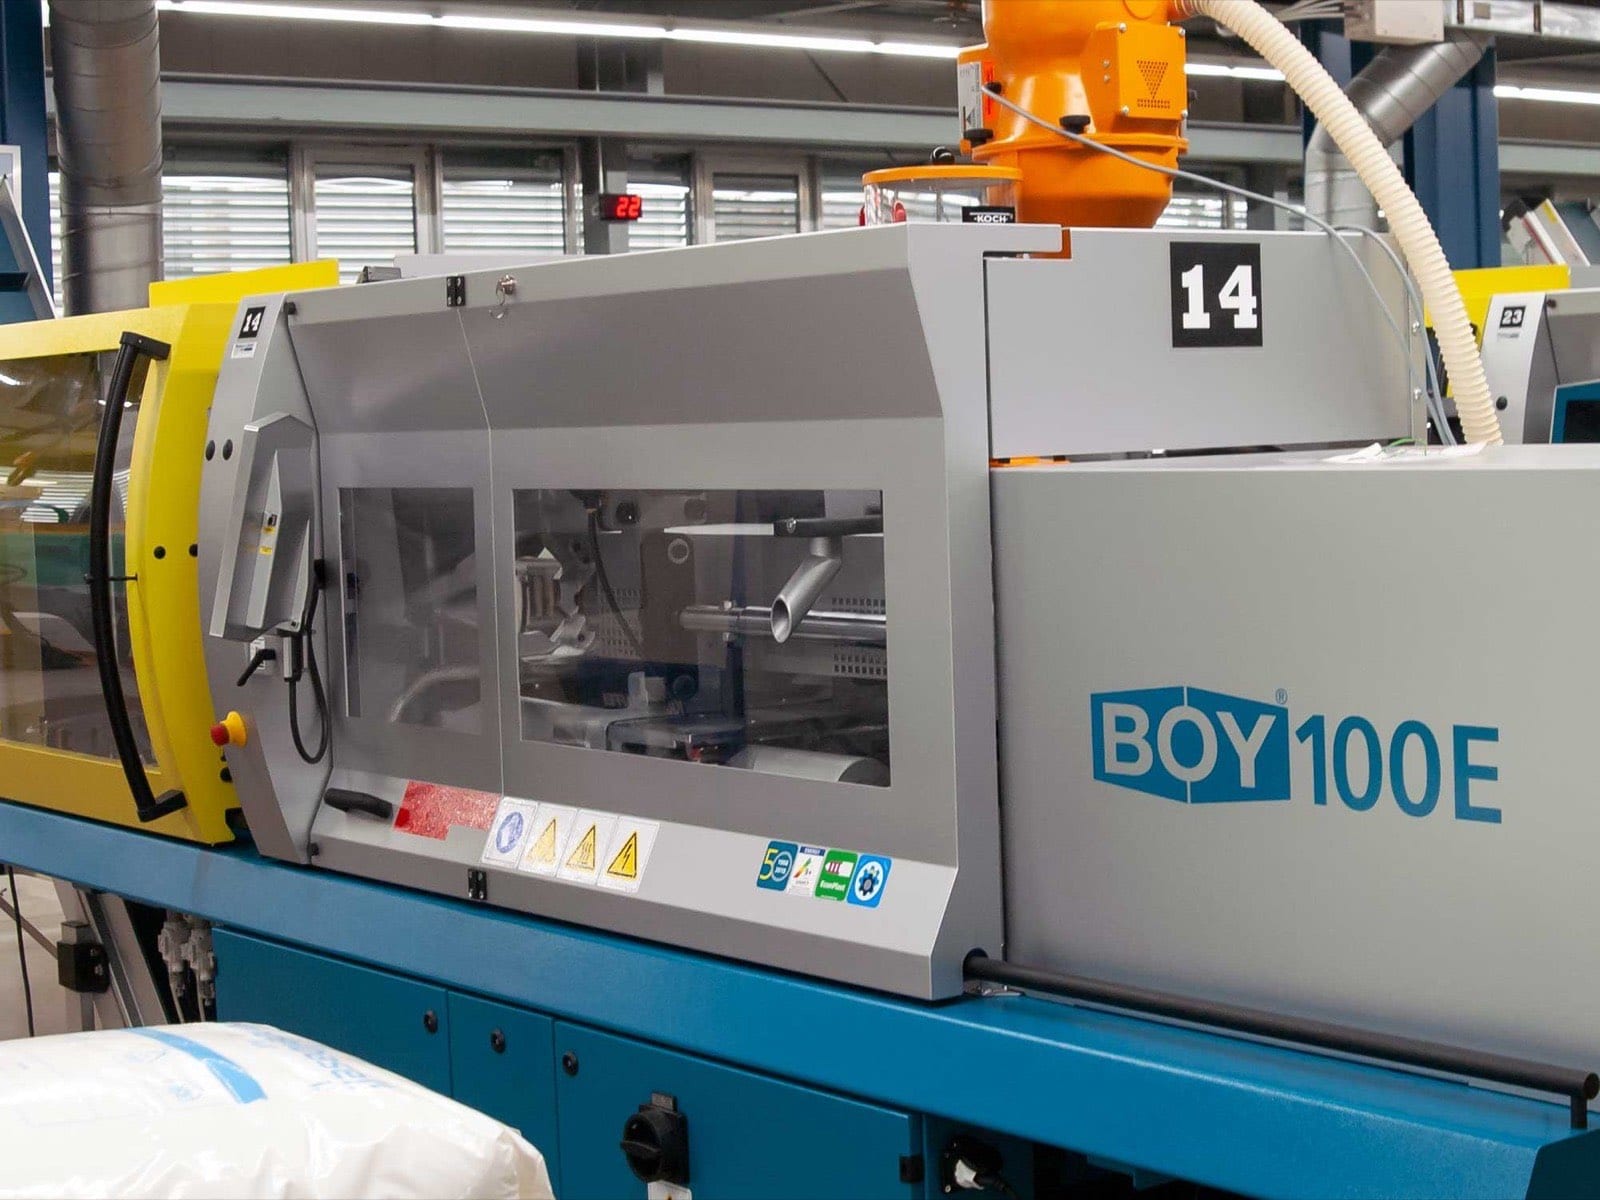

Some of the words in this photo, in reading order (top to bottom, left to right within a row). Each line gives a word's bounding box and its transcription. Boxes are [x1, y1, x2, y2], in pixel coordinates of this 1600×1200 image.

[616, 196, 641, 218] 22
[976, 214, 1007, 223] KOCH
[1181, 264, 1258, 330] 14
[242, 312, 262, 333] 14
[1501, 309, 1523, 326] 23
[1101, 701, 1277, 790] BOY
[759, 847, 793, 882] 50
